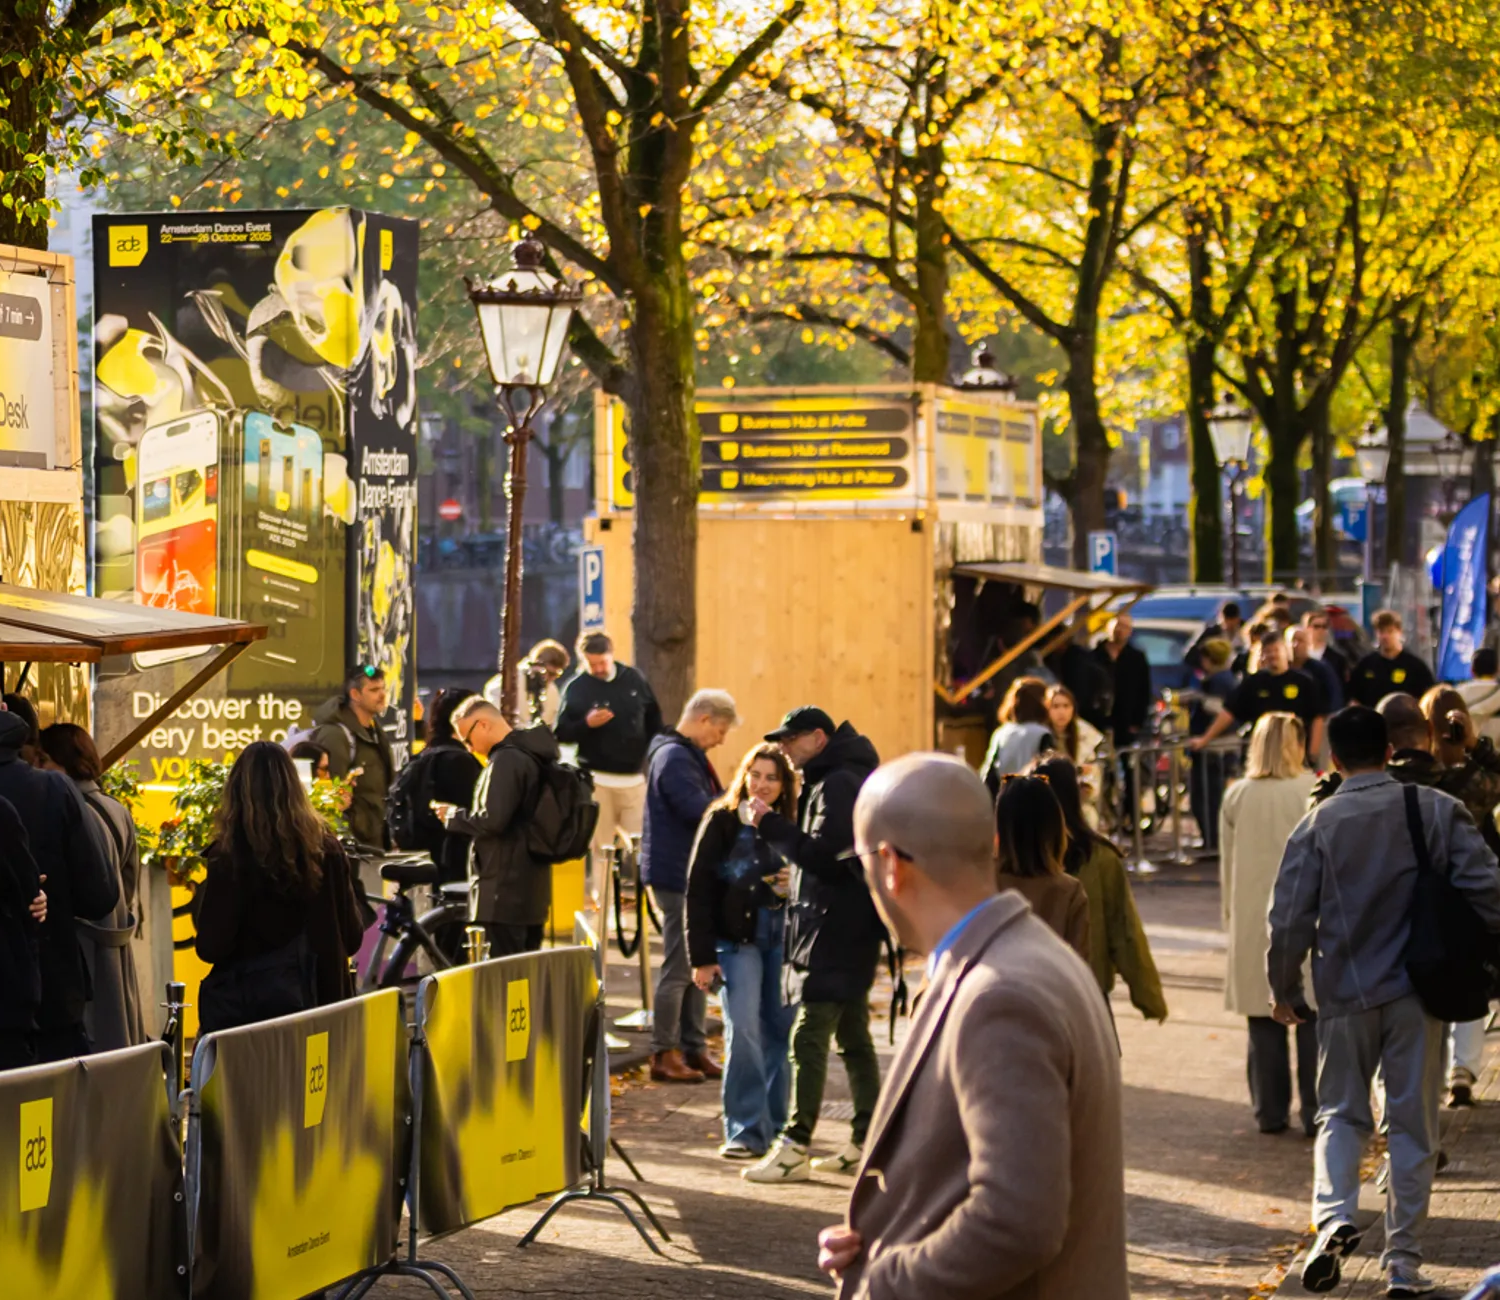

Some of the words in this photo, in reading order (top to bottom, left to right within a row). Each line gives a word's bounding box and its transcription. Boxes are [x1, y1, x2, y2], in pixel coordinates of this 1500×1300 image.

[160, 224, 212, 234] Amsterdam
[214, 223, 244, 233] Dance
[246, 222, 271, 232] Event
[211, 232, 248, 242] October
[250, 231, 272, 242] 2025
[6, 306, 10, 323] 7
[10, 308, 23, 325] min
[361, 445, 409, 476] Amsterdam
[359, 477, 387, 508] Dance
[1096, 536, 1110, 564] P
[586, 552, 600, 596] P
[258, 692, 302, 720] the
[202, 722, 262, 750] best
[510, 999, 526, 1033] ade
[310, 1056, 324, 1094] ade
[25, 1123, 48, 1174] ade
[288, 1241, 309, 1258] Amsterdam
